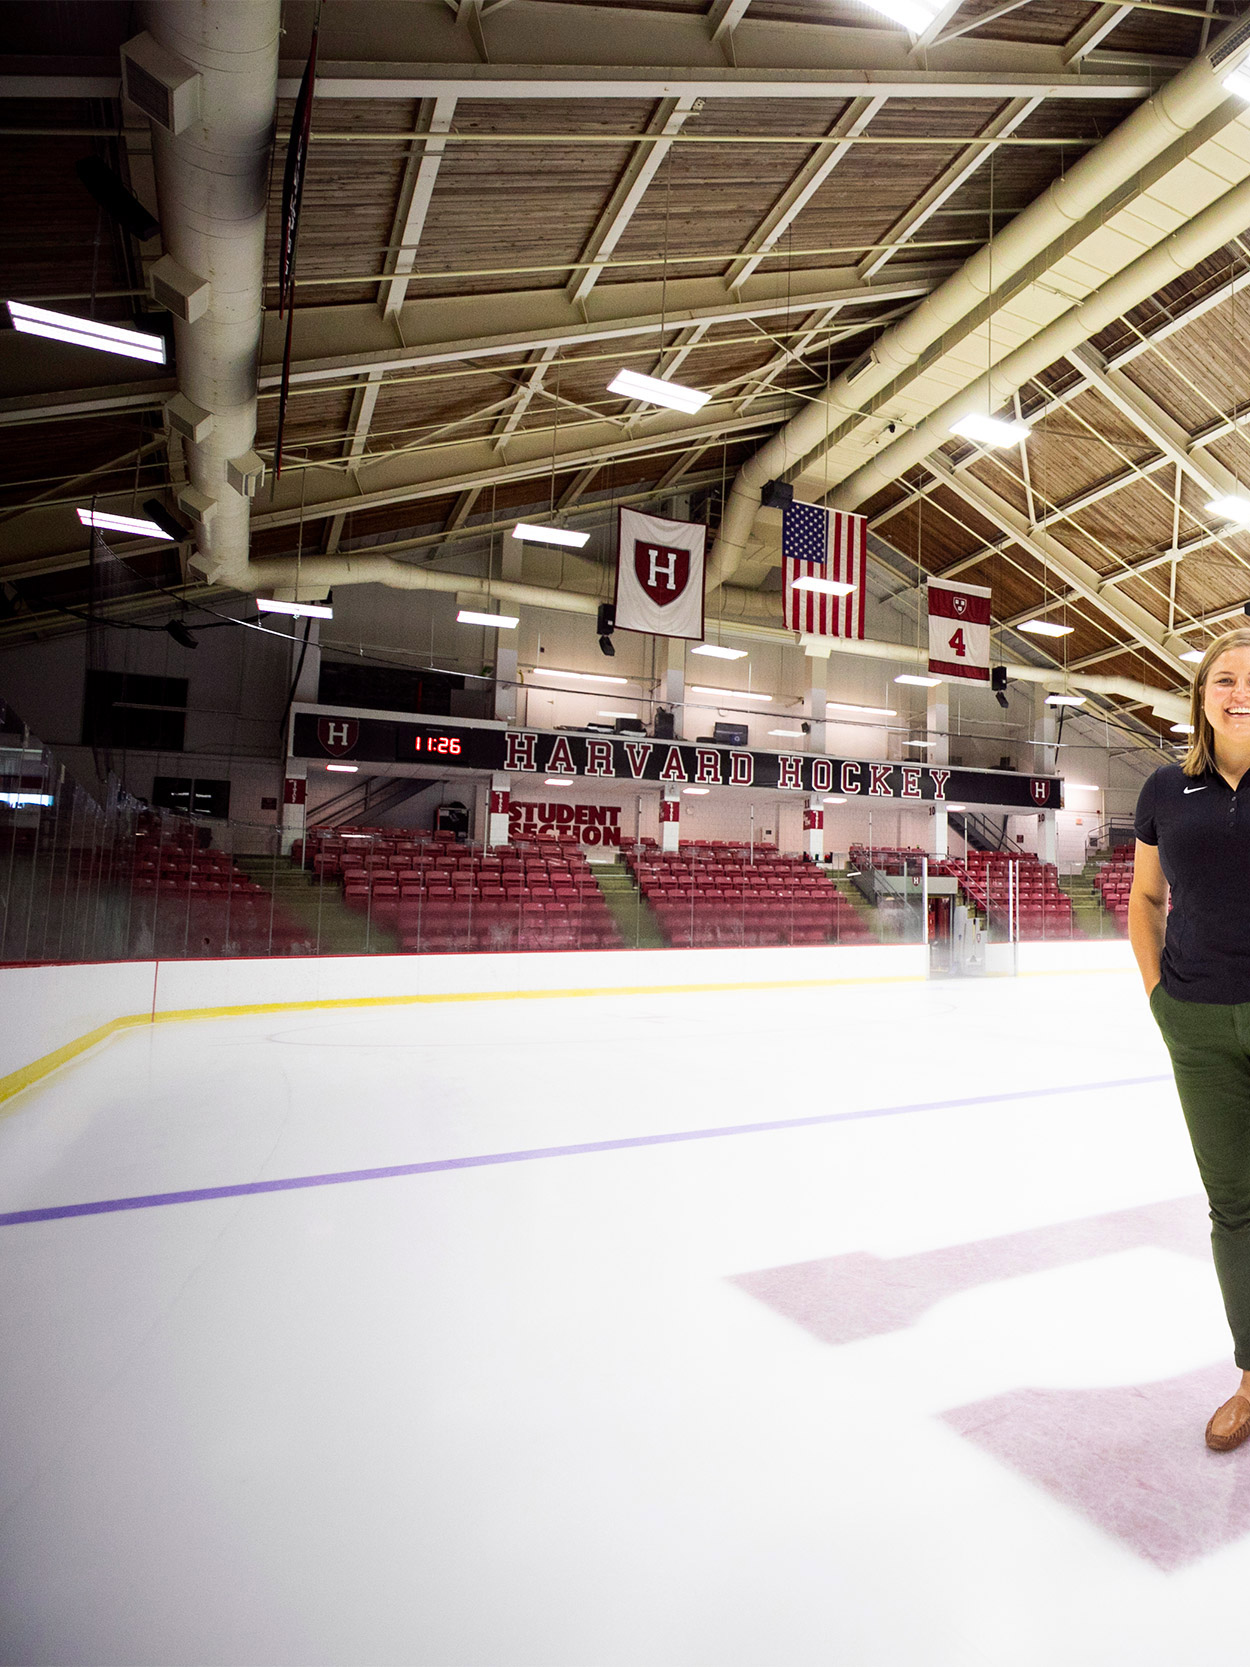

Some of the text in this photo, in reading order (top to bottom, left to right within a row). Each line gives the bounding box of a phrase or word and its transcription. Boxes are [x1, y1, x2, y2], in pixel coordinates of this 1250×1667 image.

[647, 549, 676, 590] H
[949, 628, 966, 656] 4
[328, 722, 349, 746] H
[416, 737, 461, 754] 11:26
[504, 732, 951, 800] HARVARD HOCKEY
[1035, 782, 1046, 798] H
[509, 801, 621, 826] STUDENT
[929, 807, 935, 816] 10
[1038, 814, 1045, 822] 10
